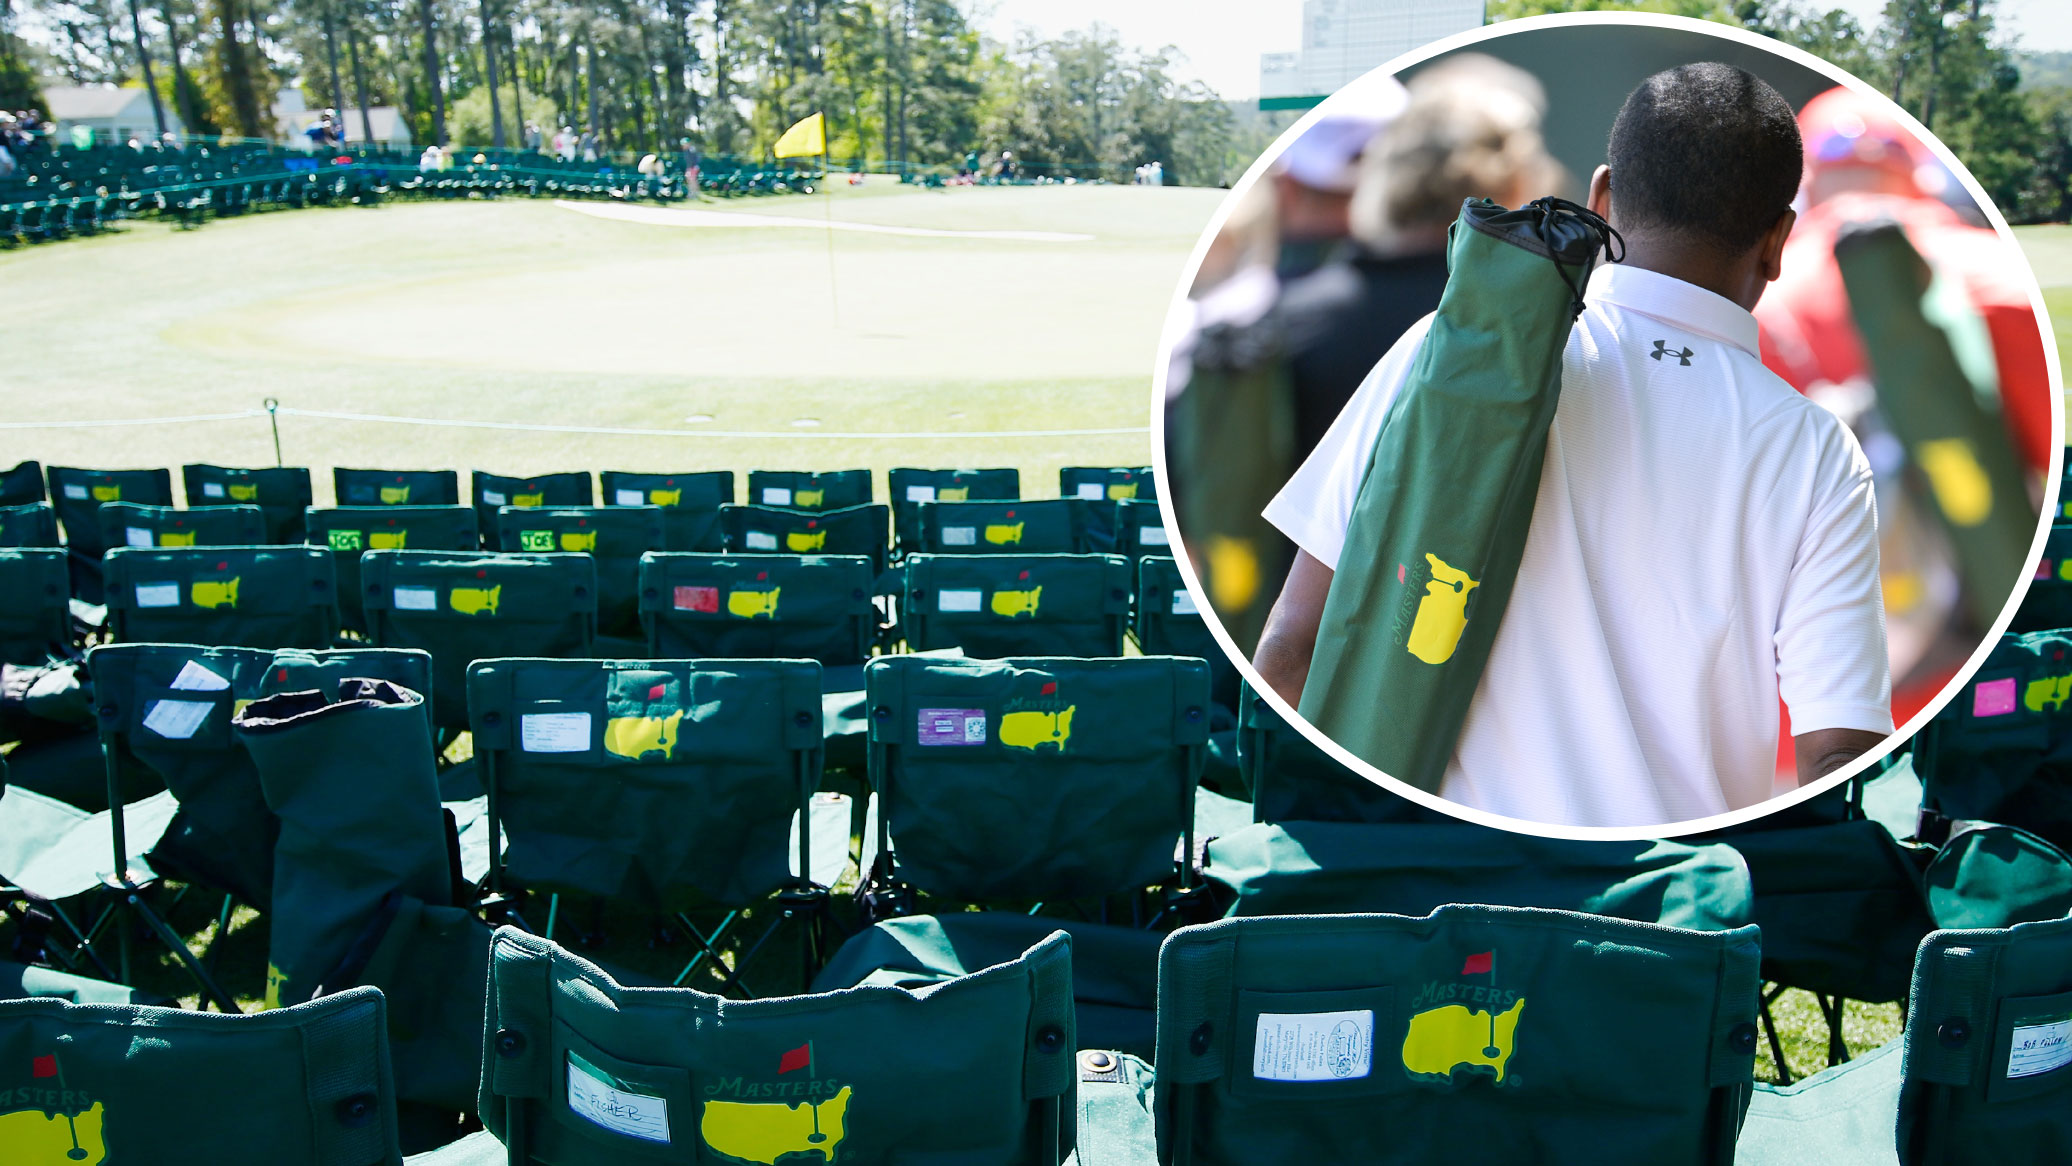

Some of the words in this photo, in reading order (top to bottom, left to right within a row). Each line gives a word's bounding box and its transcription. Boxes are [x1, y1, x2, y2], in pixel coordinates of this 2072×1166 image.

[1392, 561, 1426, 646] MASTERS
[1412, 980, 1515, 1009] MASTERS
[0, 1086, 90, 1107] ASTERS
[704, 1077, 838, 1098] MASTERS
[591, 1094, 641, 1121] FISHER
